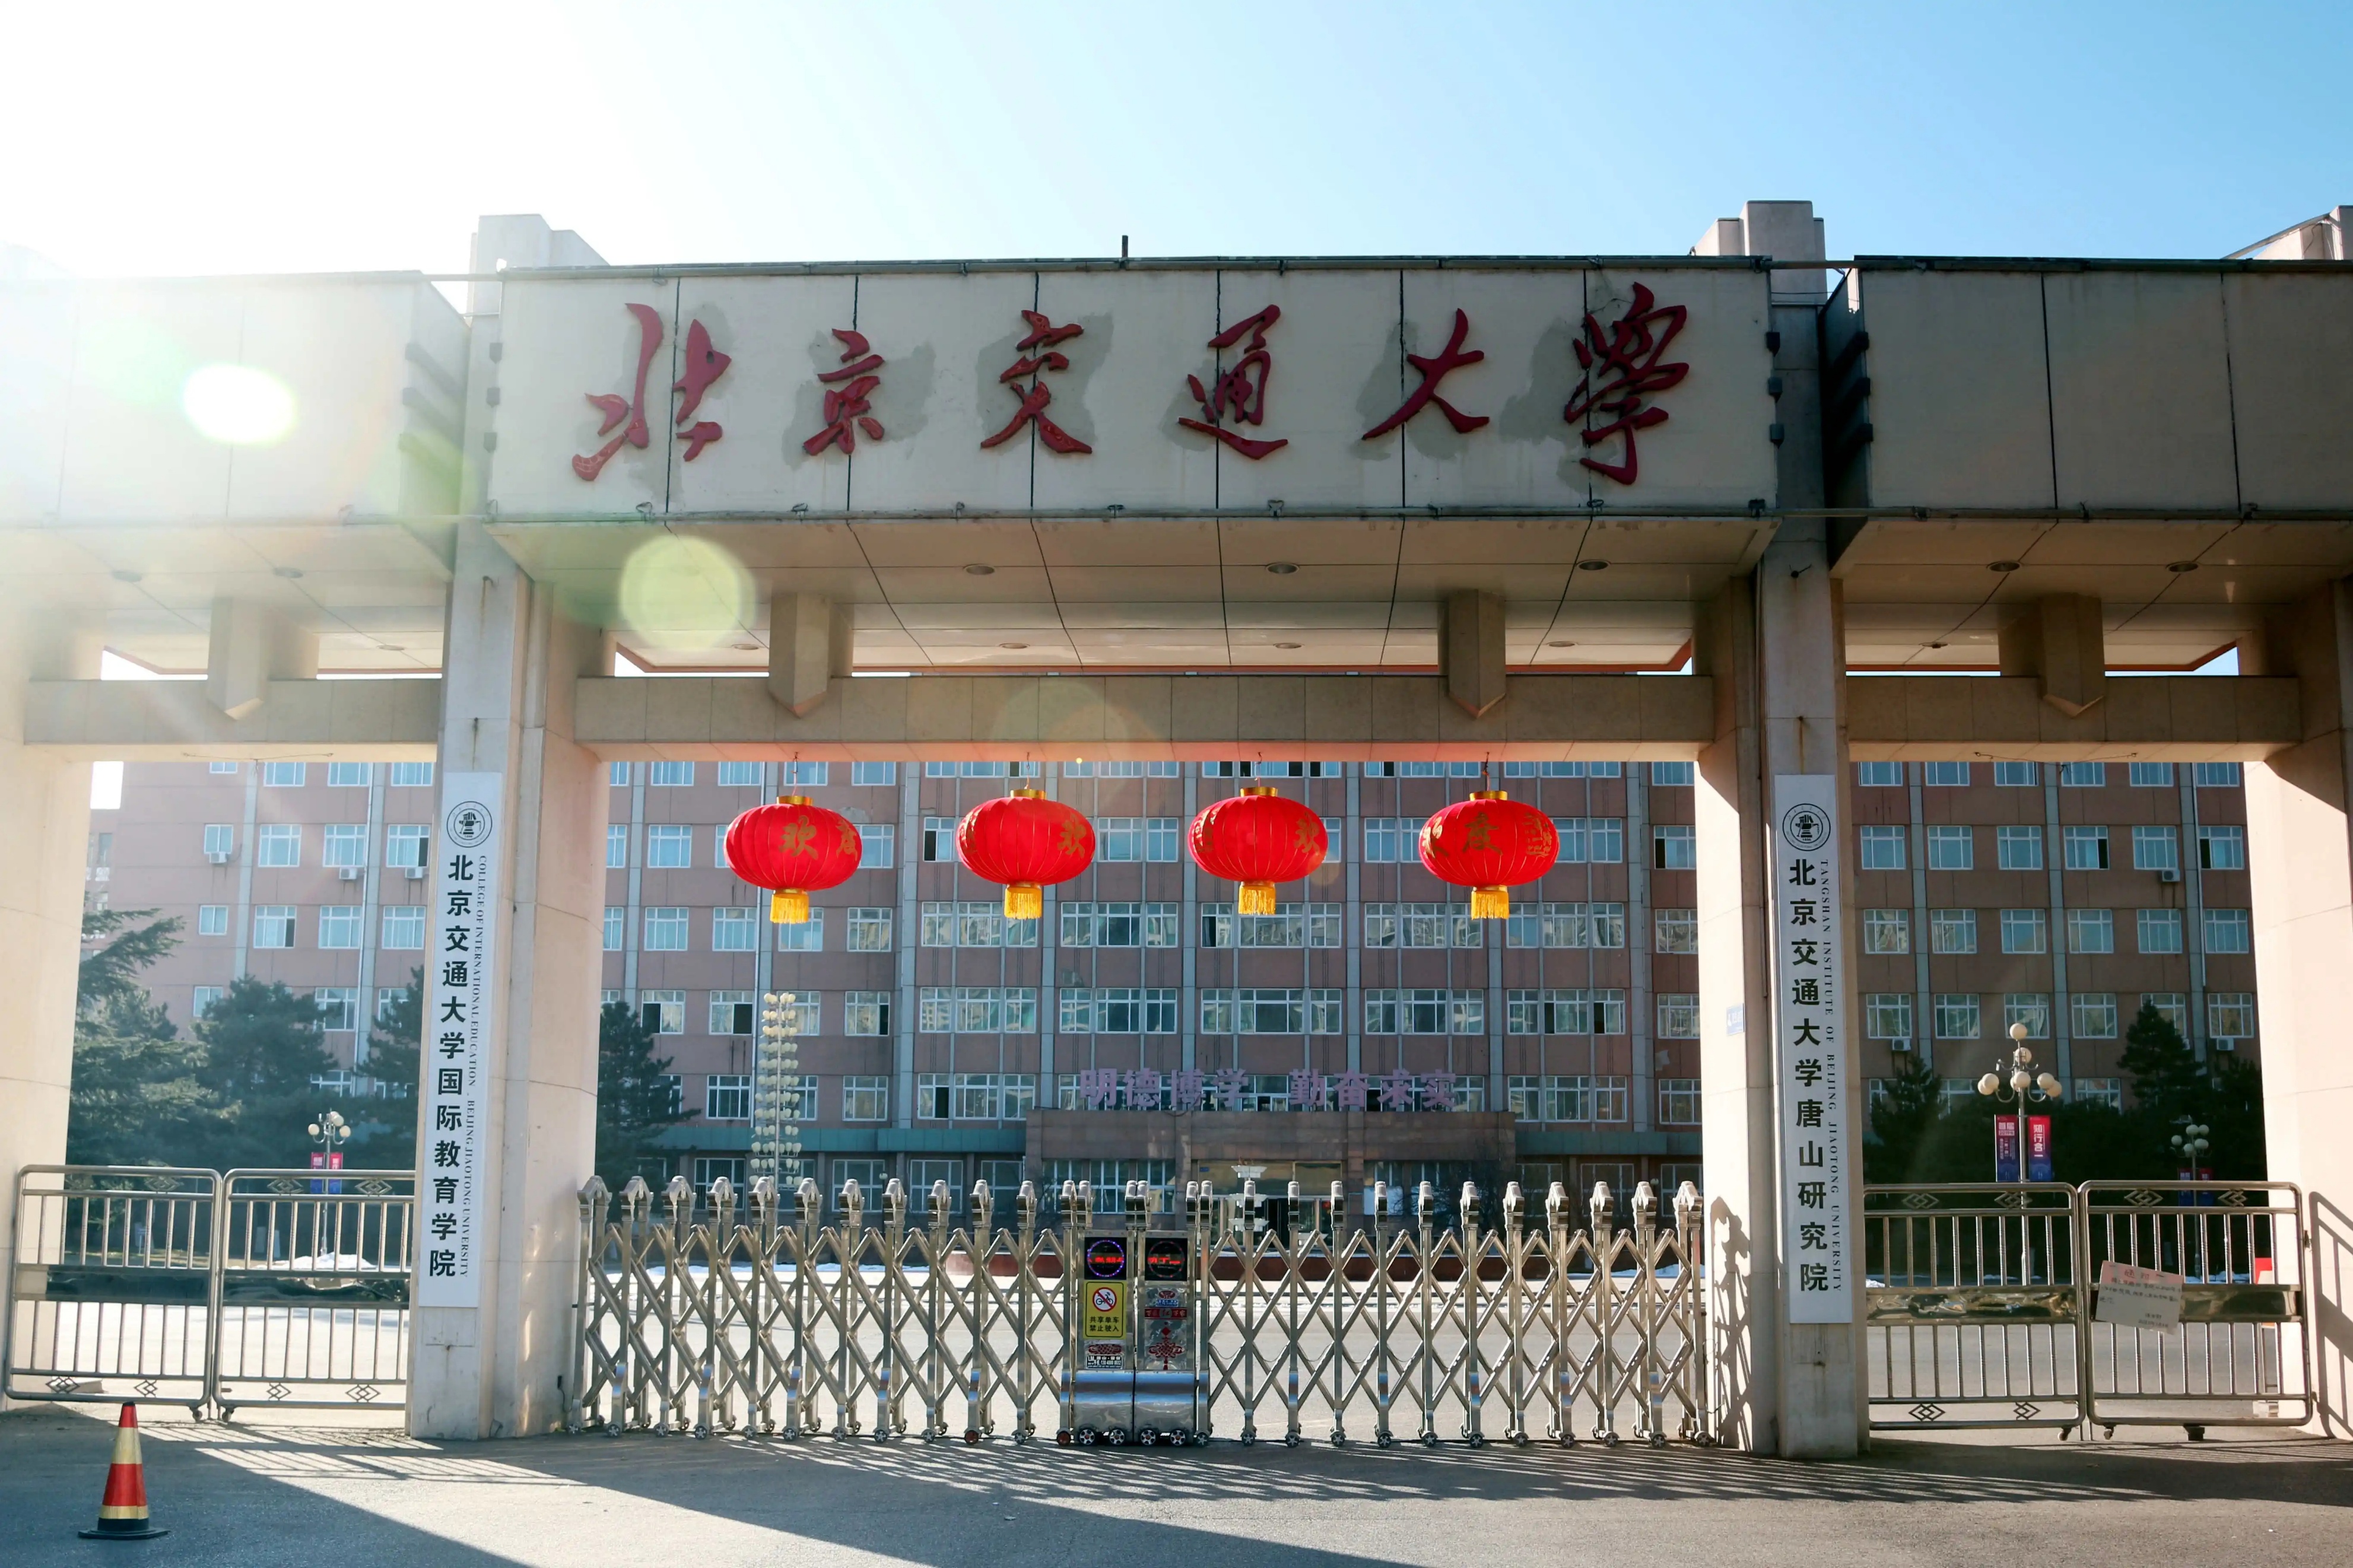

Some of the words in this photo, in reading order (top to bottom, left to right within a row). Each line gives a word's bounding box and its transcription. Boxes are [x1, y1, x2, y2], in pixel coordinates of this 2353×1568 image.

[477, 855, 487, 907] COLLEGE
[1821, 859, 1831, 932] TANGSHAN
[476, 909, 484, 924] OF
[471, 927, 483, 1018] INTERNATIONAL
[1823, 942, 1834, 1015] INSTITUTE
[430, 854, 474, 1277] 北京交通大学国际教育学院
[468, 1021, 478, 1086] EDUCATION
[1826, 1026, 1834, 1043] OF
[1079, 1068, 1248, 1108] 明德博学
[1288, 1068, 1456, 1108] 勤奋求实
[1789, 859, 1828, 1292] 北京交通大学唐山研究院
[1827, 1054, 1836, 1110] BEIJING
[466, 1100, 475, 1144] BEIJING
[463, 1147, 473, 1205] JIAOTONG
[1828, 1122, 1839, 1193] JIAOTONG
[460, 1208, 471, 1277] UNIVERSITY
[1831, 1206, 1841, 1291] UNIVERSITY
